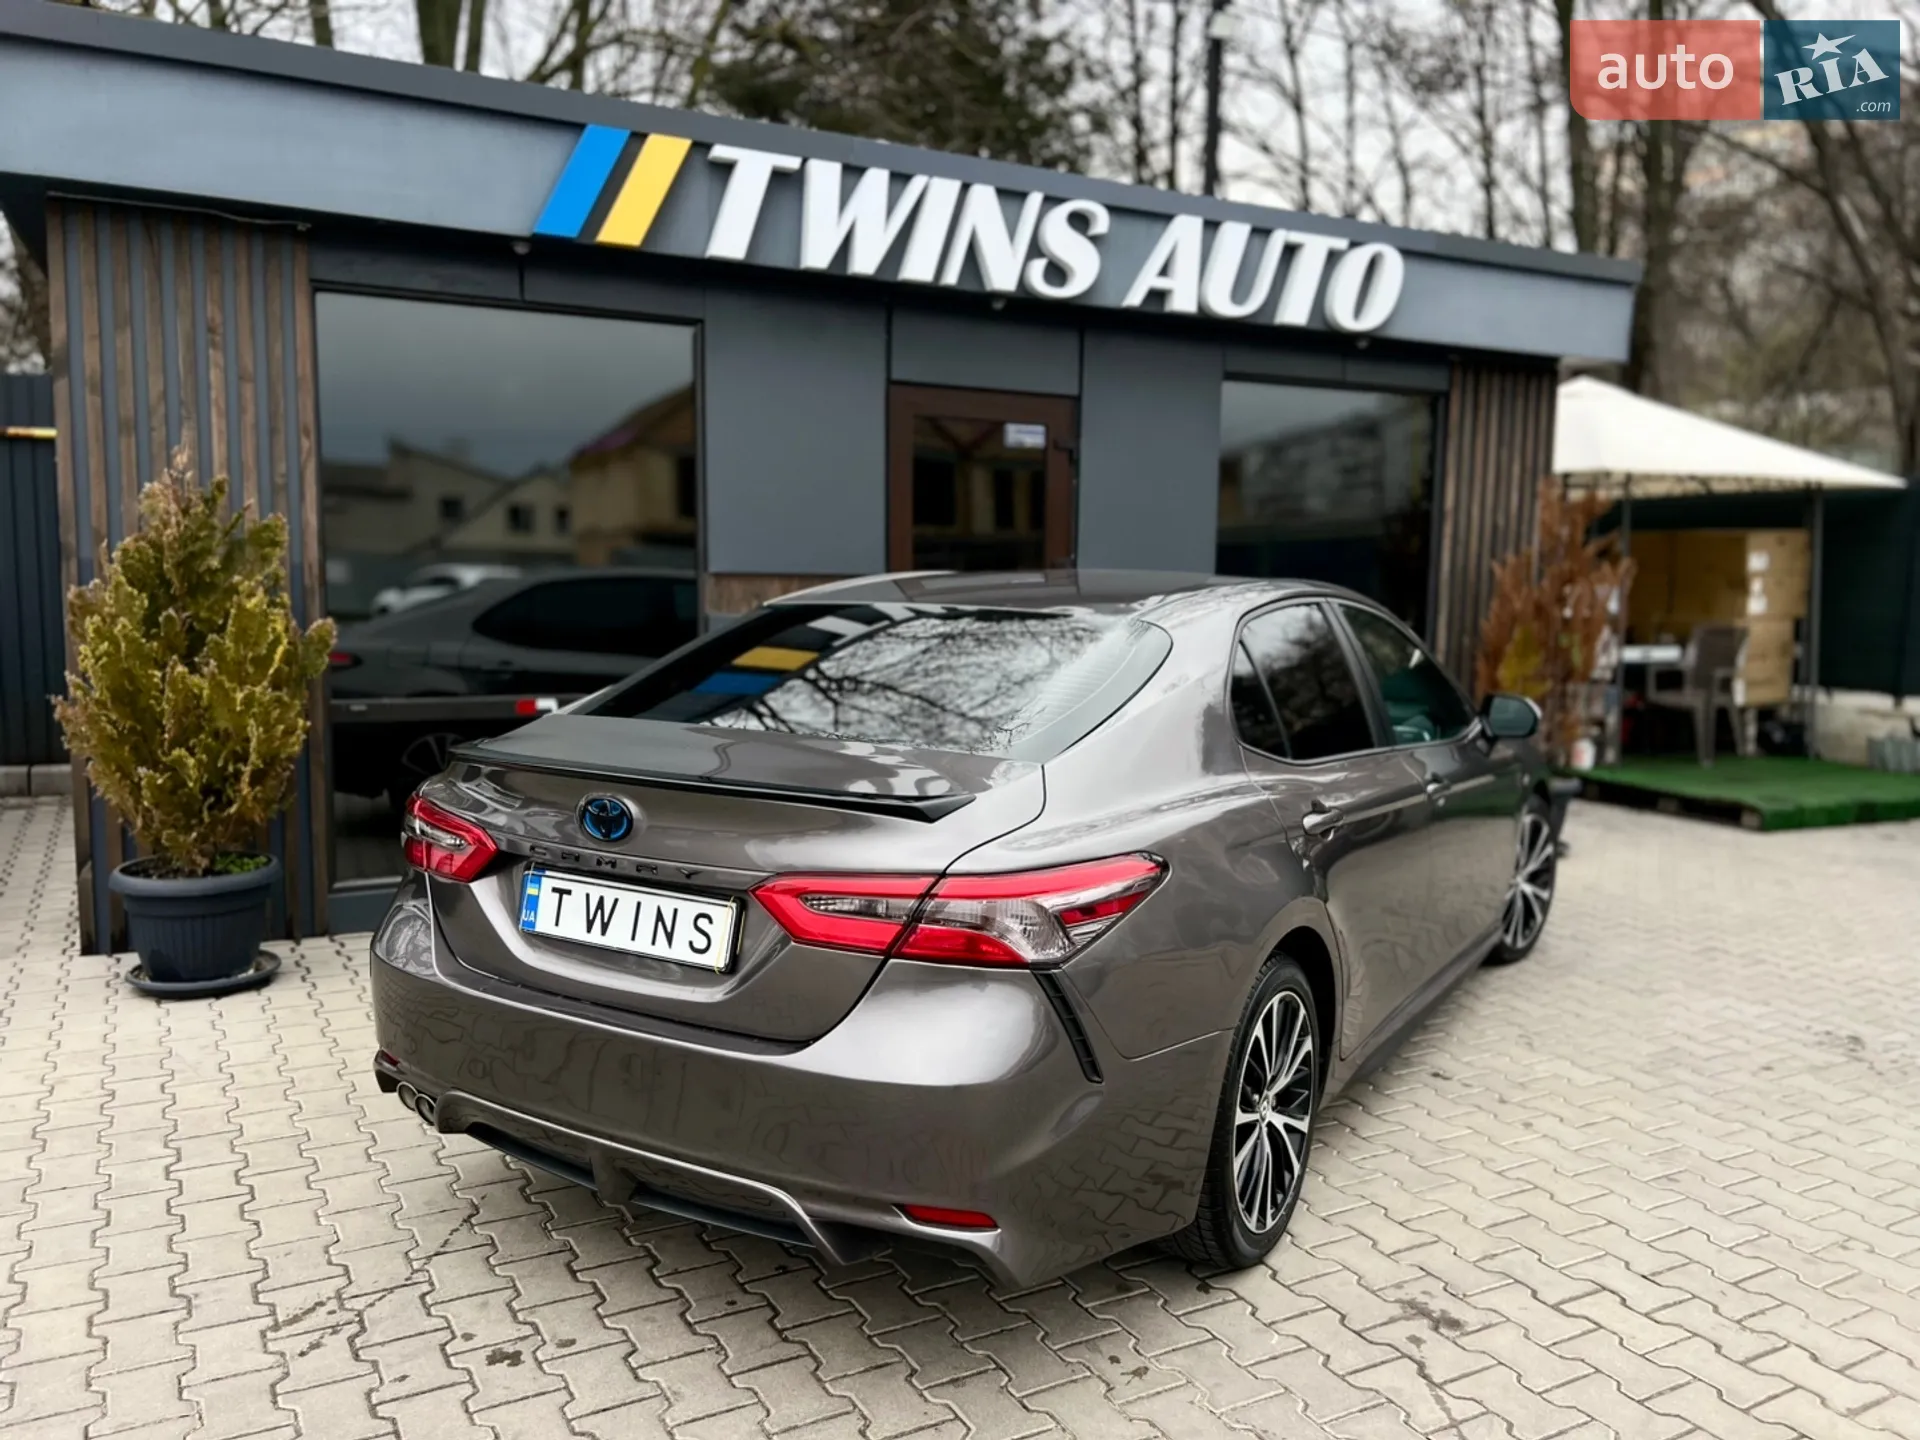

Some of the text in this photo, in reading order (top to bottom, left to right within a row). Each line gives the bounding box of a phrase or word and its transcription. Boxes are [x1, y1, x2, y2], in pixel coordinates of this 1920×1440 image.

[704, 144, 1405, 333] TWINS AUTO
[522, 909, 536, 923] UA
[551, 886, 714, 955] TWINS
